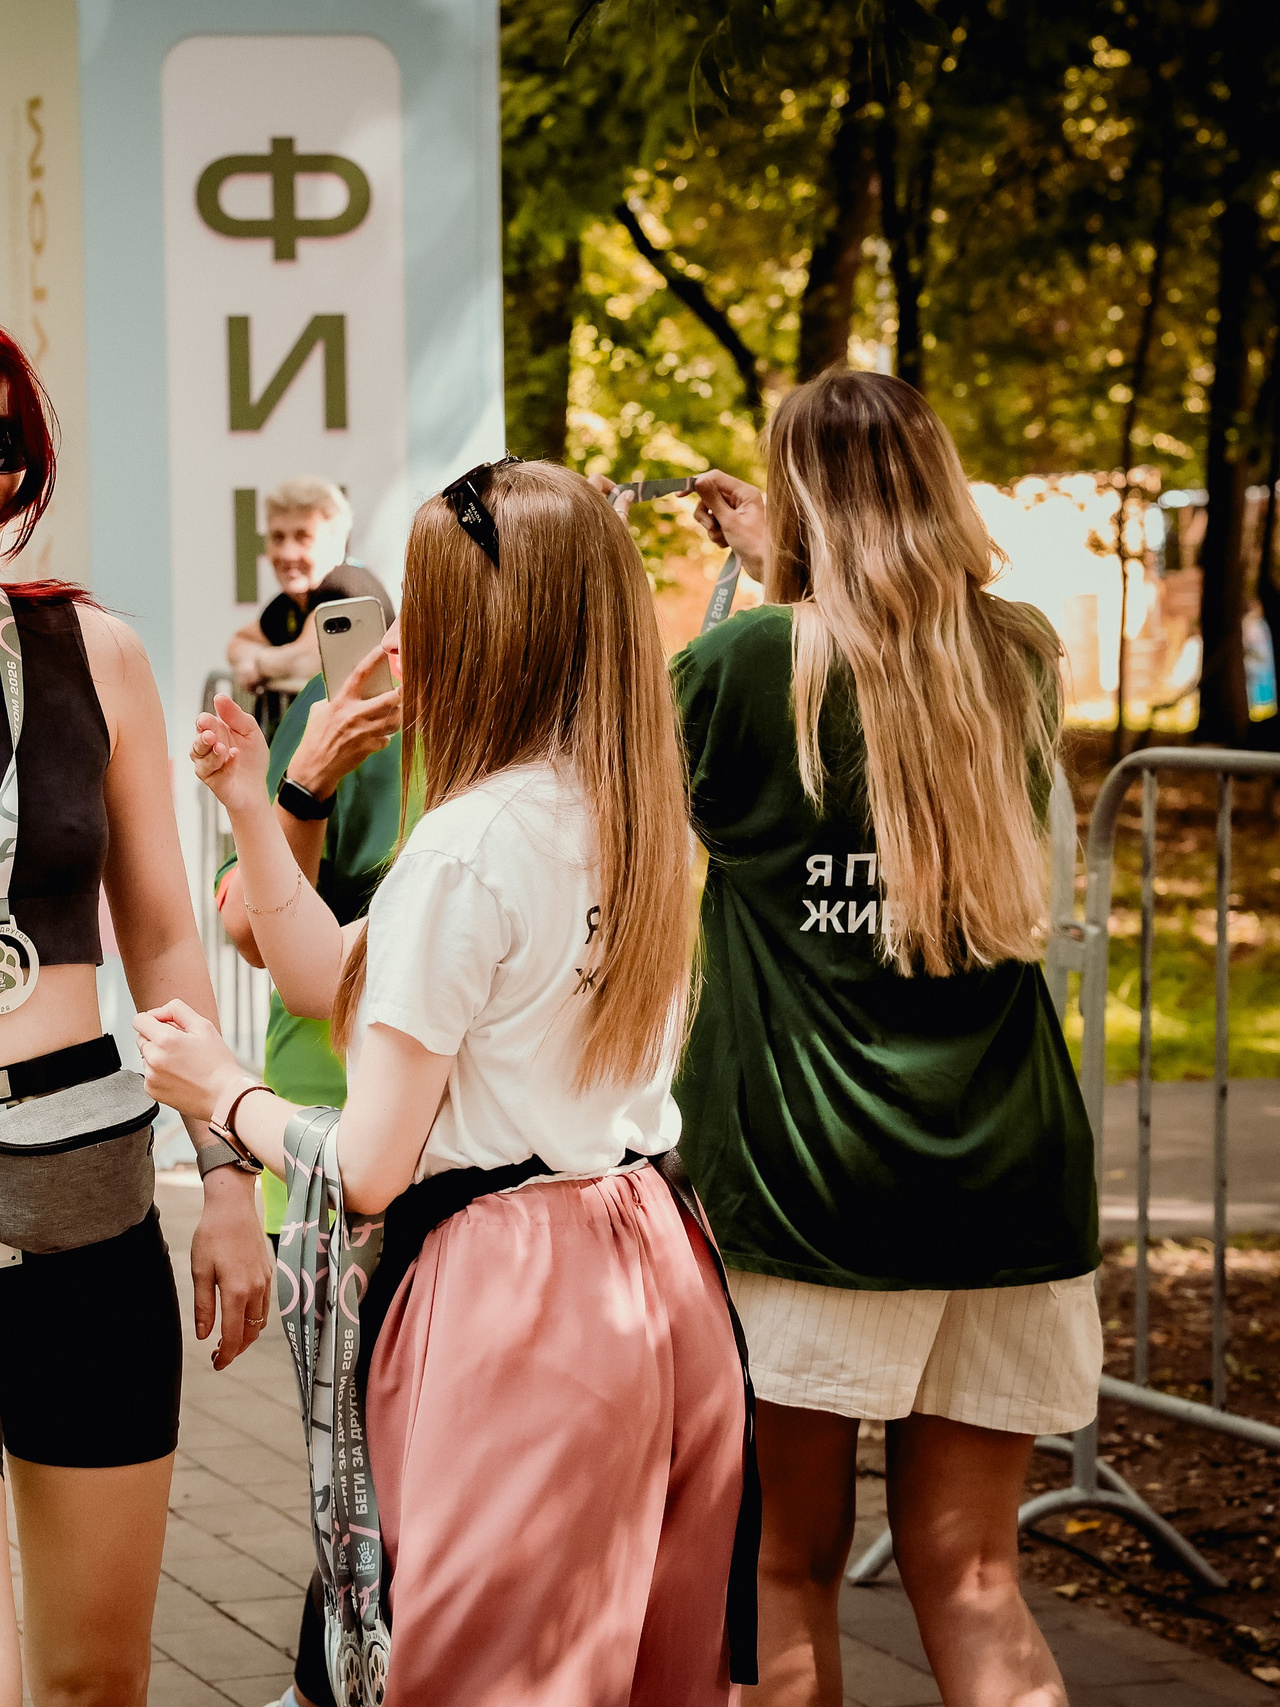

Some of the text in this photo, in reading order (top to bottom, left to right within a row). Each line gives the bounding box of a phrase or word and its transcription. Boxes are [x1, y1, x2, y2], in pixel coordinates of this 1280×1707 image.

[468, 502, 482, 524] PRADA
[6, 660, 21, 741] УГОМ 2026
[805, 853, 833, 887] Я
[0, 926, 30, 945] ДРУГОМ
[342, 1328, 354, 1371] 2026
[337, 1375, 348, 1443] ДРУГОМ
[338, 1447, 347, 1470] ЗА
[351, 1445, 364, 1468] ЗА
[353, 1472, 368, 1515] БЕГИ
